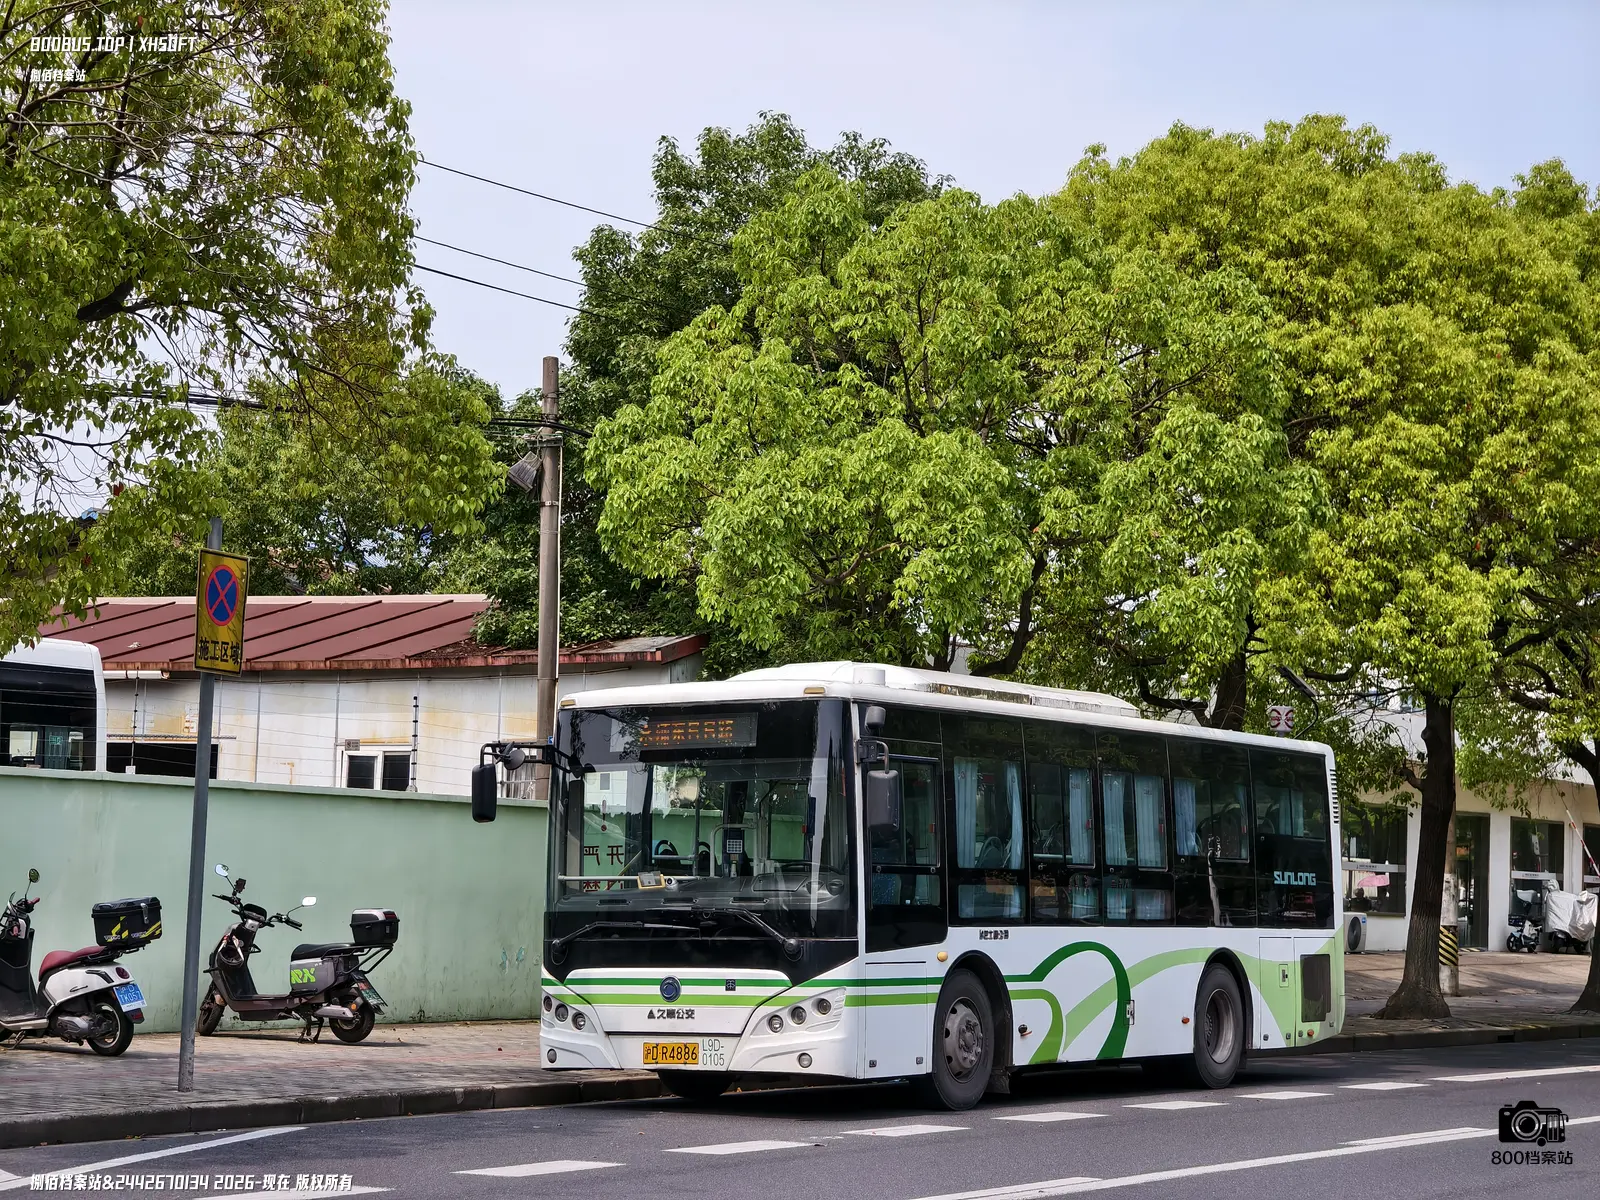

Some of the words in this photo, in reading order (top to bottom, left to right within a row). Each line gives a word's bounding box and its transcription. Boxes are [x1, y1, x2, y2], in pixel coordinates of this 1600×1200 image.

[199, 638, 240, 665] 施工区域
[1273, 871, 1317, 886] SUNLONG
[657, 1008, 695, 1019] 久事公交
[702, 1039, 725, 1052] L9D-
[702, 1053, 725, 1066] 0105
